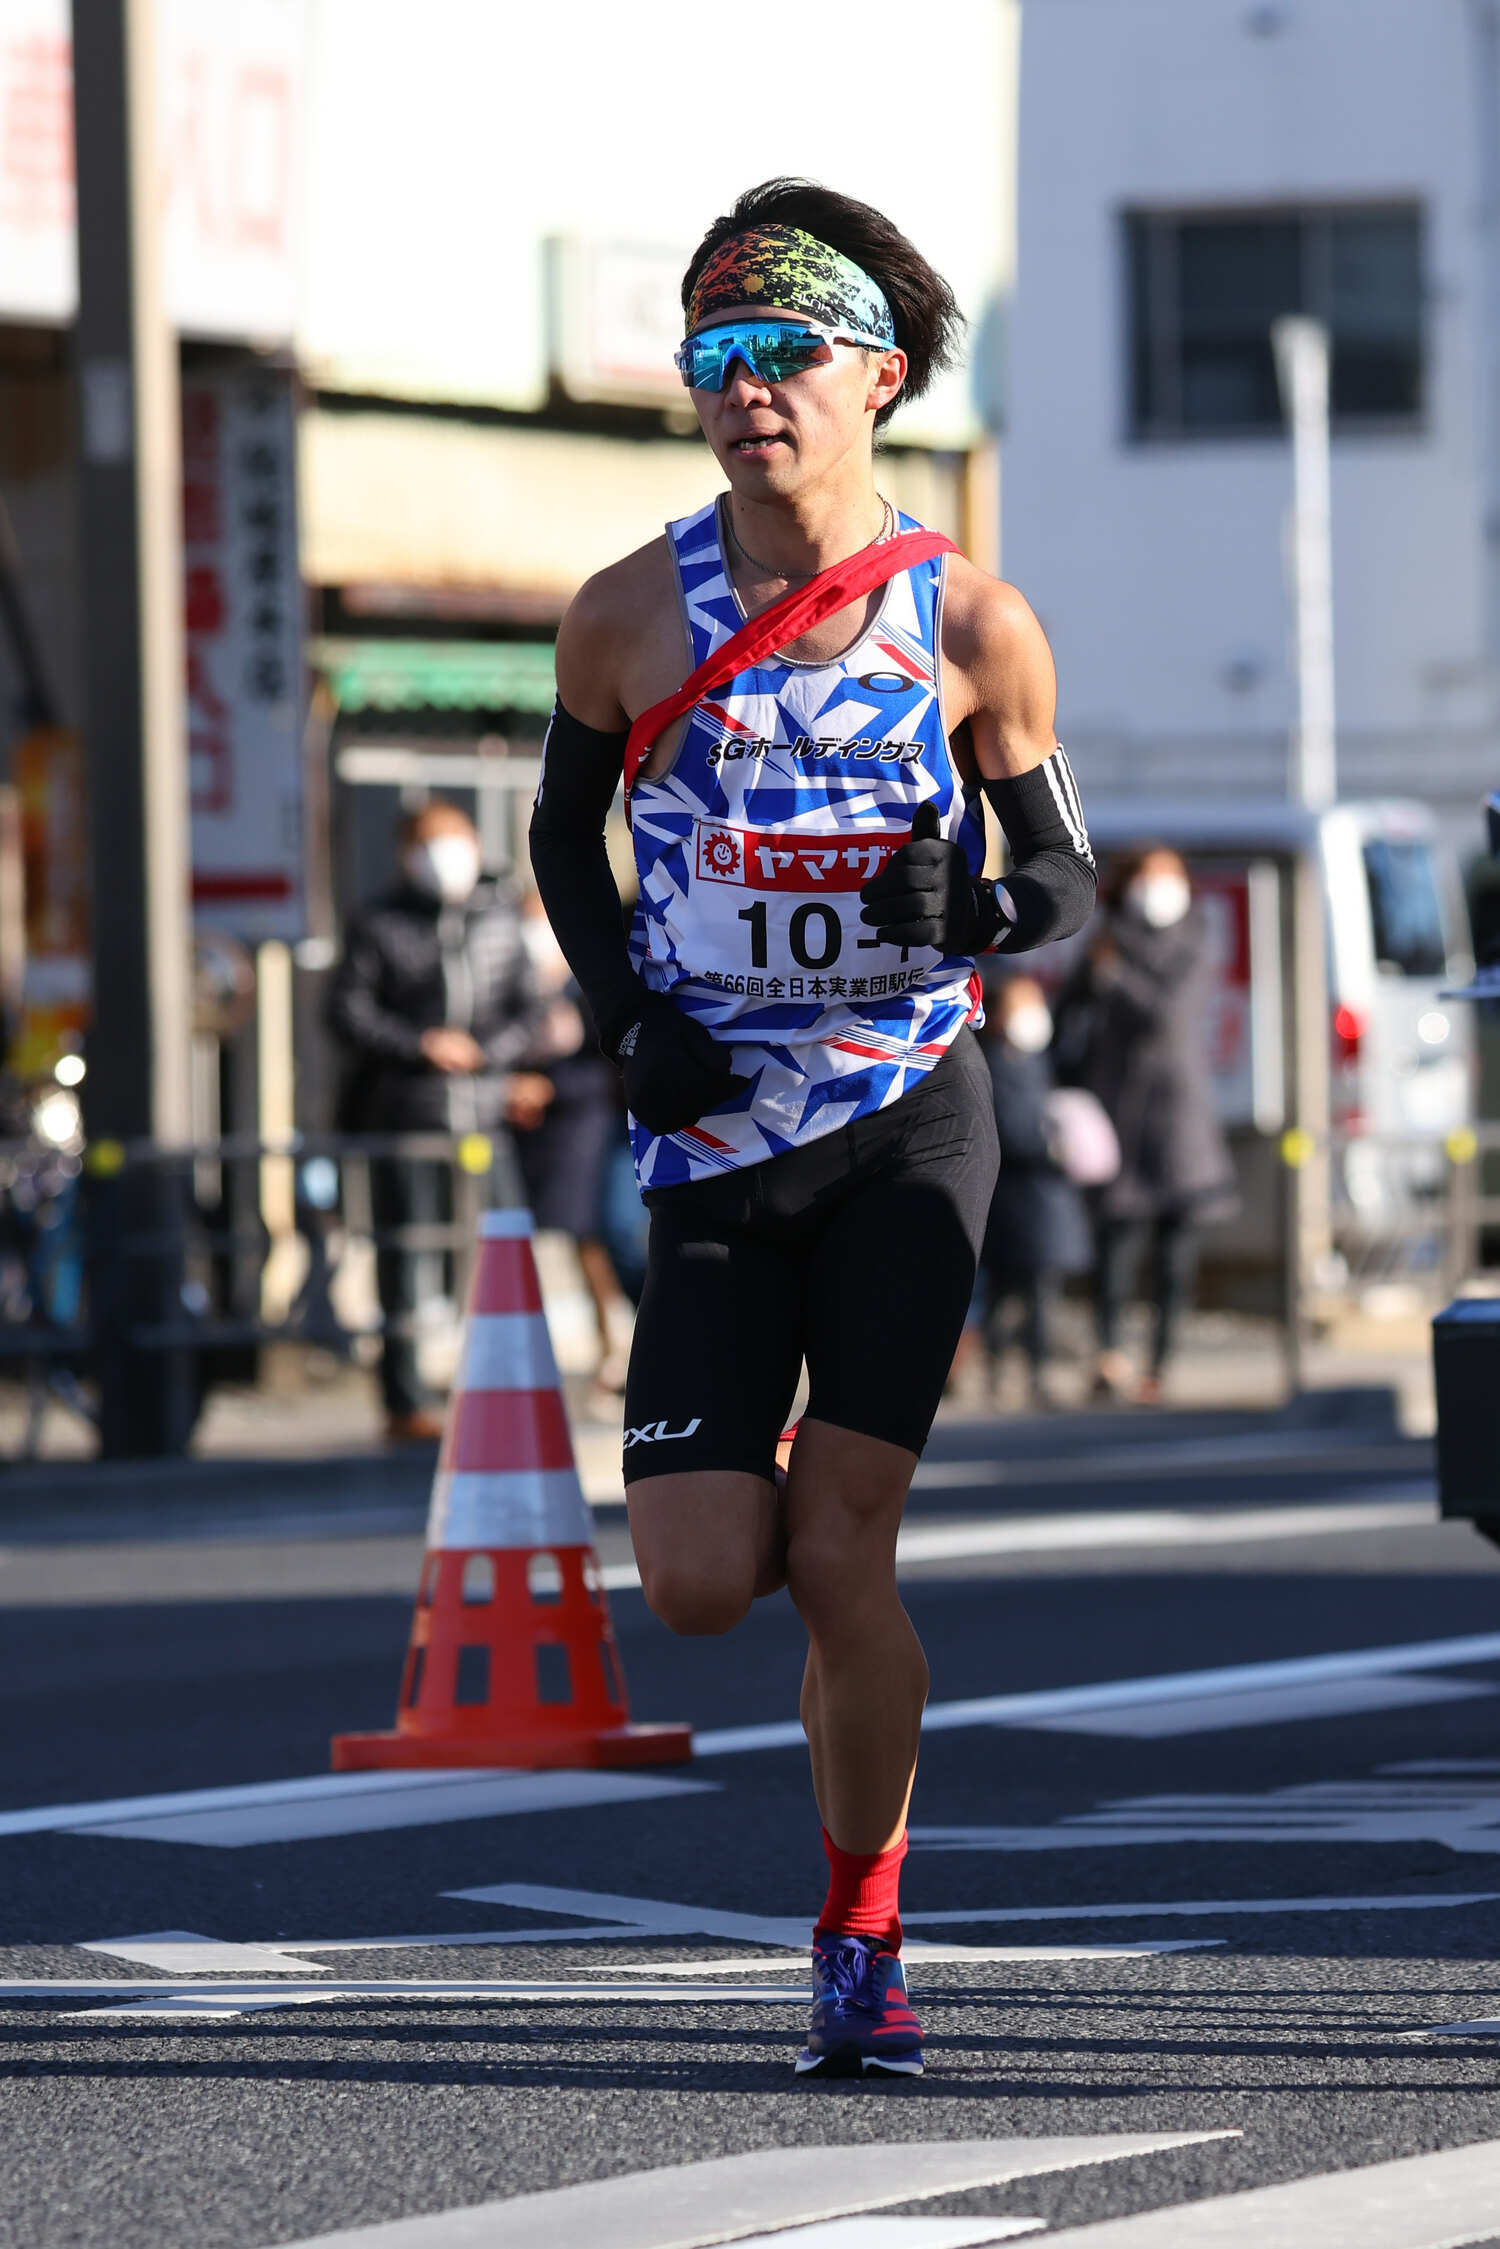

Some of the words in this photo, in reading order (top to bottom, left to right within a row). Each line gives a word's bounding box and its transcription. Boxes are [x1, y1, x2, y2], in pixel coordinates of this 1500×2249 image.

[706, 736, 925, 767] SGホールディングス
[754, 845, 899, 881] ヤマザ
